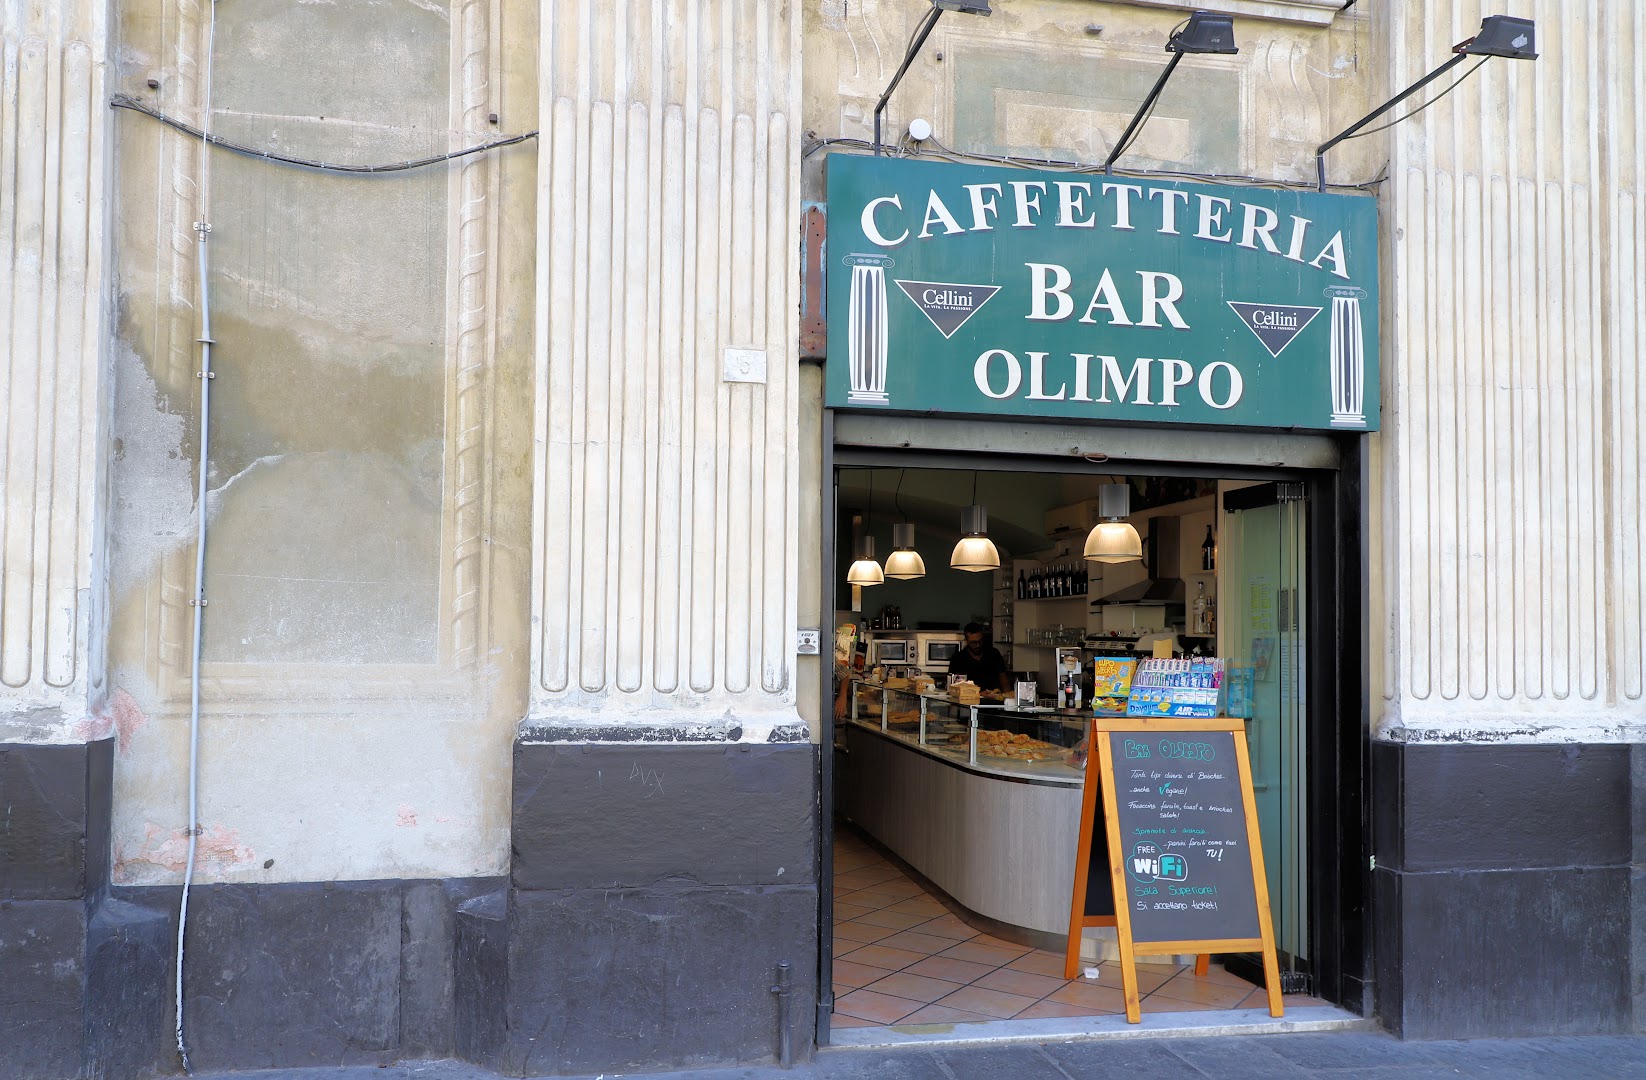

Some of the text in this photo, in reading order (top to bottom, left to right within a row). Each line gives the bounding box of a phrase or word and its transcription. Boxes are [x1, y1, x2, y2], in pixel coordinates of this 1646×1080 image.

[860, 180, 1350, 280] CAFFETTERIA
[922, 289, 973, 306] Cellini
[1024, 263, 1190, 329] BAR
[1252, 310, 1297, 326] Cellini
[973, 349, 1243, 409] OLIMPO
[1098, 659, 1115, 667] LUPO
[1159, 739, 1215, 761] OLIMPO
[1130, 769, 1147, 779] Tanti
[1150, 770, 1162, 780] tipi
[1164, 771, 1183, 779] diversi
[1187, 771, 1196, 779] di
[1183, 802, 1198, 811] toast
[1137, 846, 1155, 854] FREE
[1206, 848, 1224, 861] TU!
[1135, 885, 1218, 897] Sala Superiore!
[1136, 900, 1218, 911] Si accettano ticket!
